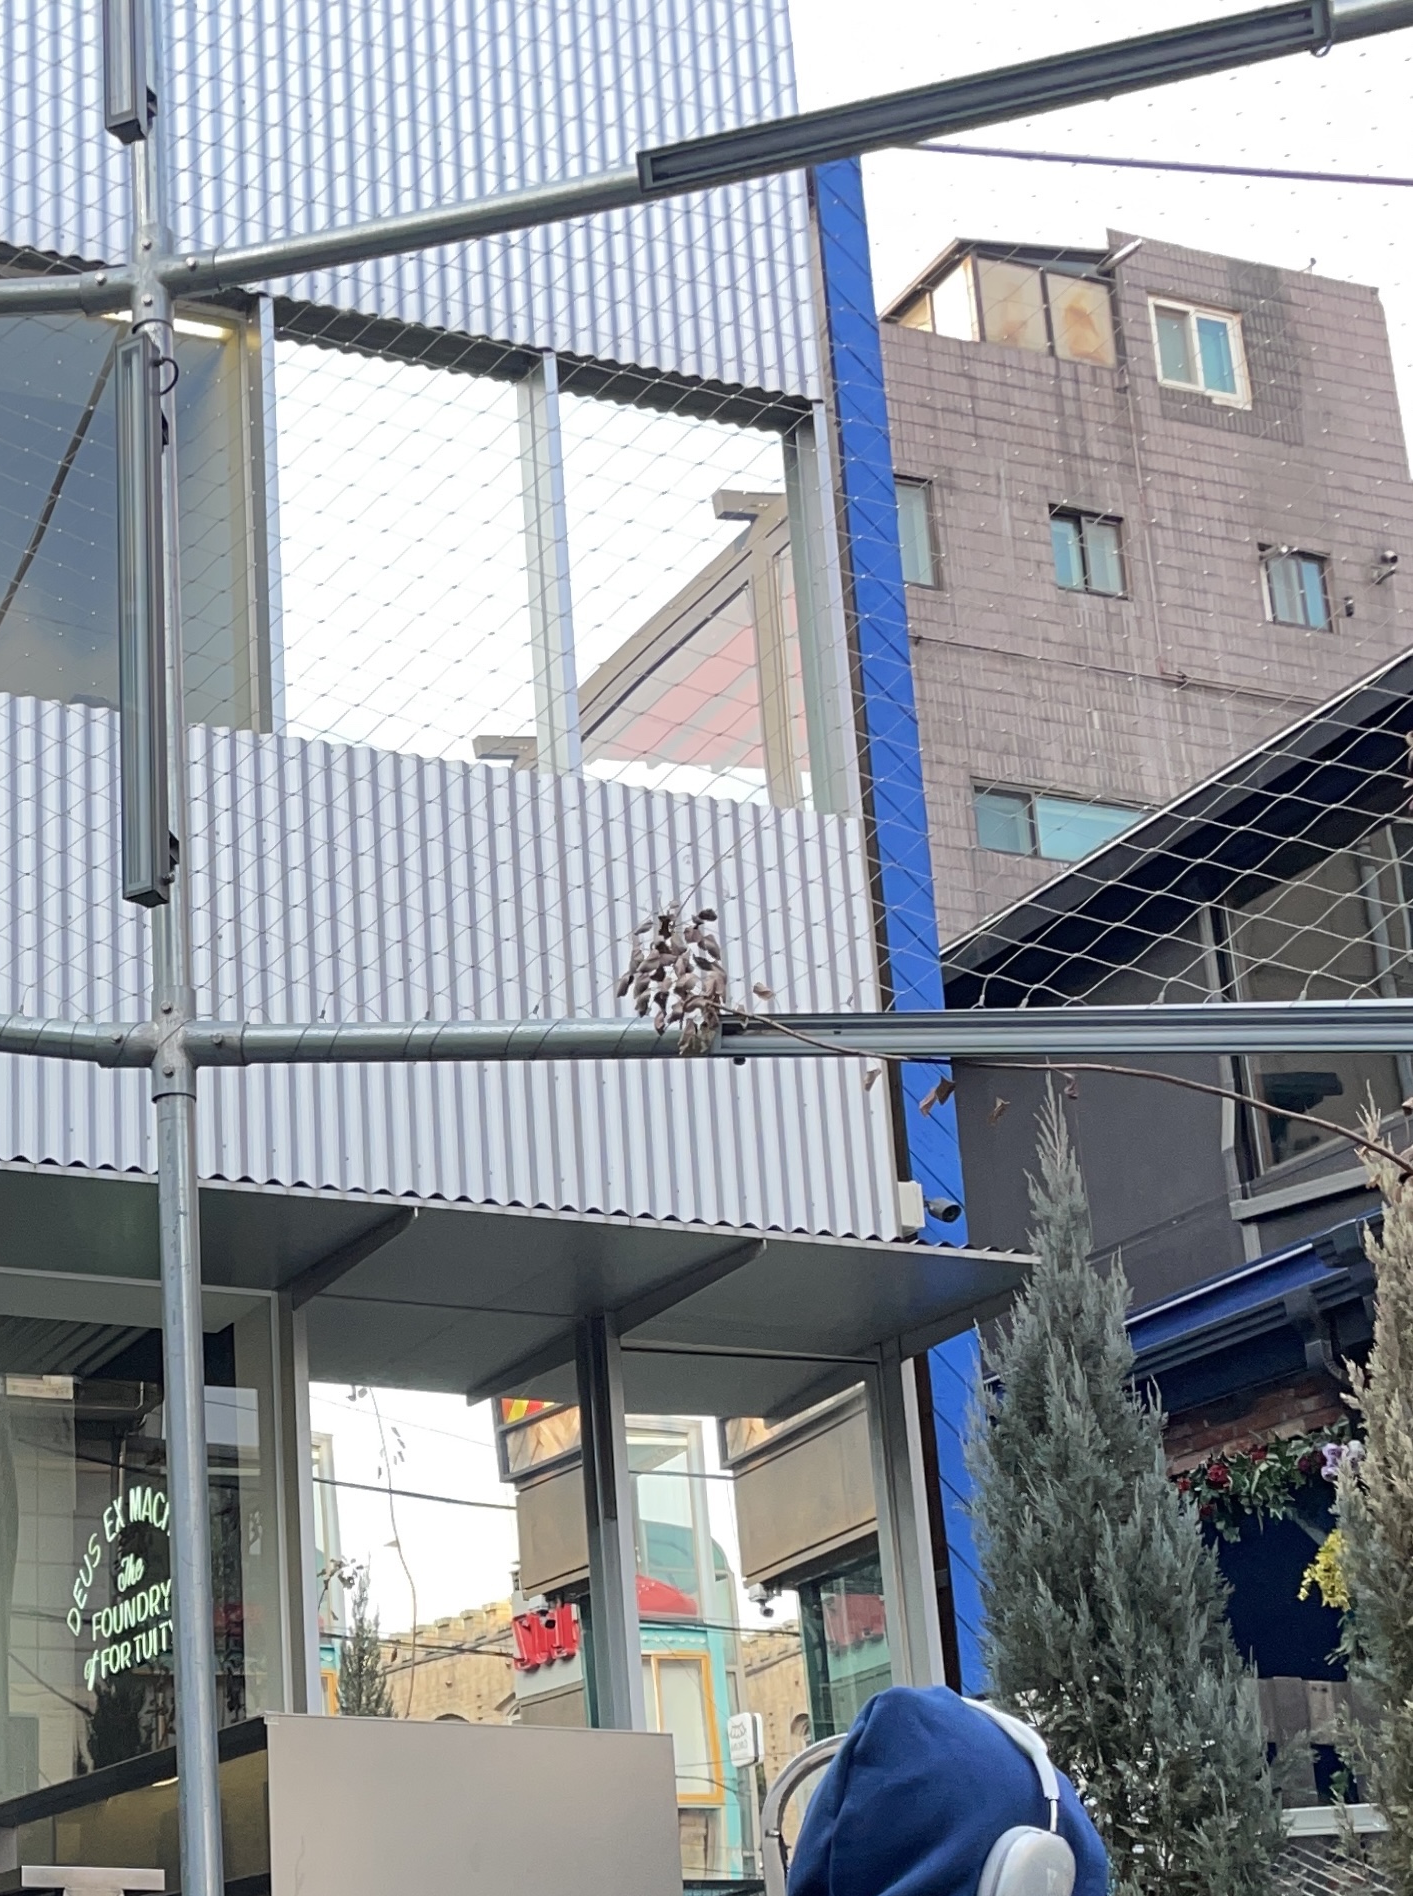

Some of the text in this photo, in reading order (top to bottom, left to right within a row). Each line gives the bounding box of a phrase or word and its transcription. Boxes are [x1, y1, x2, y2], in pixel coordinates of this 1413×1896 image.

[67, 1533, 101, 1637] DEUS
[103, 1495, 125, 1543] EX
[117, 1553, 144, 1592] The
[92, 1579, 172, 1641] FOUNDRY
[84, 1649, 99, 1691] of
